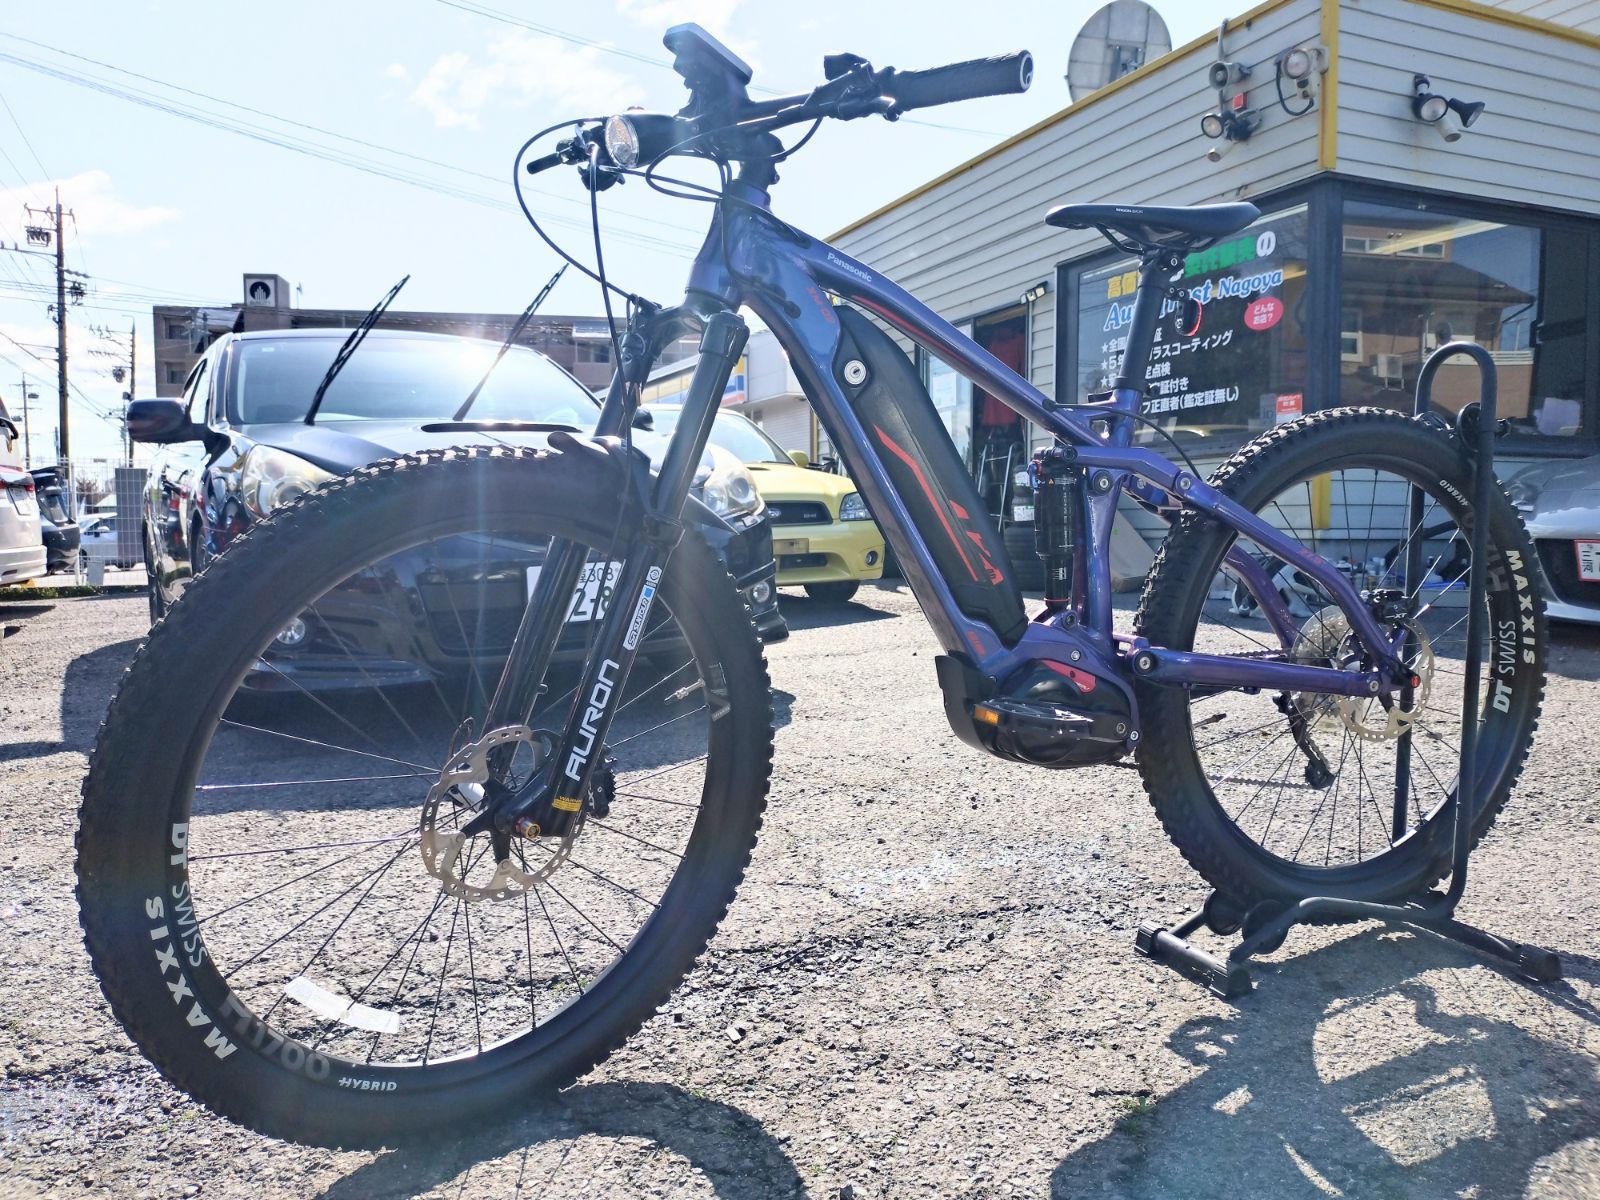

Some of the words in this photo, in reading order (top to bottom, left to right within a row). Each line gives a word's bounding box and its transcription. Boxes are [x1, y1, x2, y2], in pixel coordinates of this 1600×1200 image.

[827, 252, 872, 282] Panasonic
[1217, 269, 1284, 299] Nagoya
[1149, 329, 1233, 361] ラスコーティング
[1149, 377, 1190, 395] 証付き
[1439, 479, 1469, 507] HYBRID
[633, 598, 650, 632] SUNTOUR
[1506, 550, 1536, 665] MAXXIS
[1499, 620, 1516, 676] SWISS
[1492, 679, 1513, 714] DT
[565, 658, 620, 782] AURON
[170, 822, 189, 870] DT
[172, 881, 209, 967] SWISS
[145, 896, 238, 1060] MAXXIS
[338, 1075, 398, 1092] HYBRID
